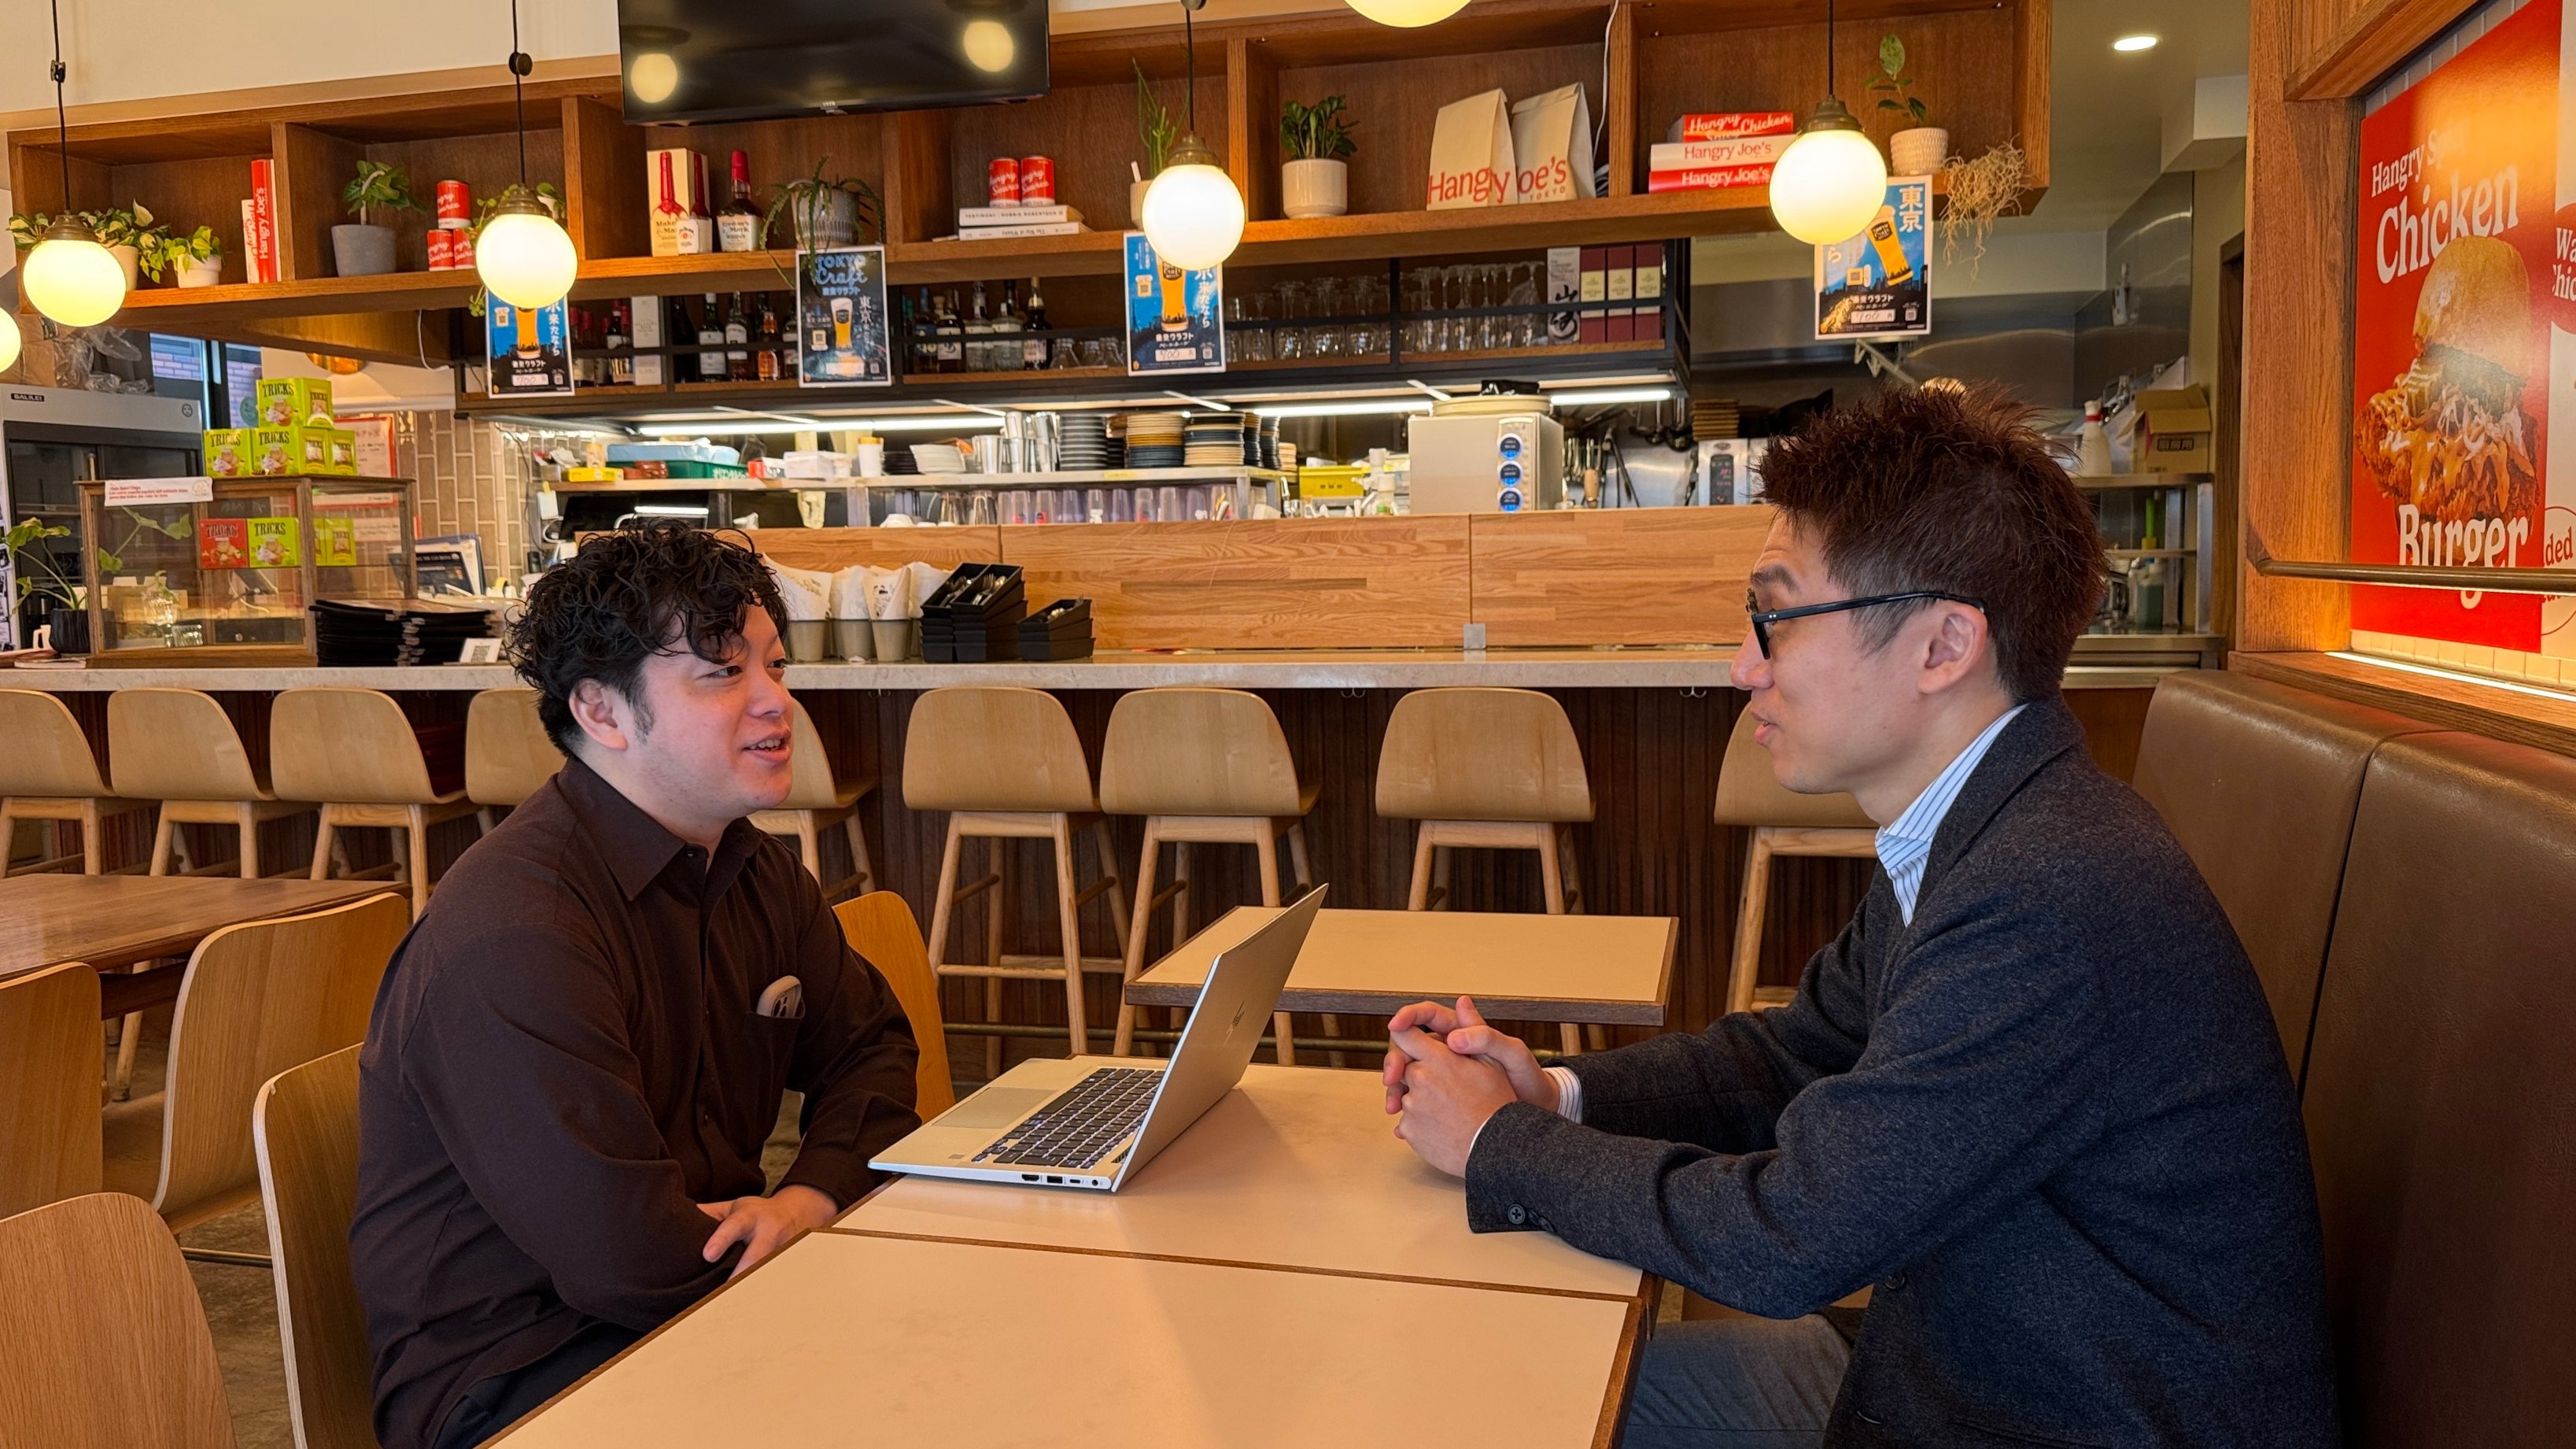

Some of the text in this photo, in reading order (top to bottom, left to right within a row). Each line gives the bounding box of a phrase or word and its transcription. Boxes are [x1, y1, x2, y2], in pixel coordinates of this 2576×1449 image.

[1688, 113, 1791, 134] Hangry Chicken
[1685, 142, 1772, 161] Hangry Joe's
[1517, 156, 1567, 194] oe's
[1681, 166, 1770, 188] Hangry Joe's
[2371, 145, 2425, 198] Hangry
[256, 187, 266, 217] Joe's
[1530, 186, 1566, 201] TOKYO
[1899, 186, 1923, 233] 東京
[2377, 164, 2519, 284] Chicken
[258, 216, 270, 260] Hangry
[815, 254, 866, 268] TOKYO
[816, 267, 868, 287] Craft
[262, 383, 294, 397] TRICKS
[210, 434, 241, 448] TRICKS
[258, 431, 290, 445] TRICKS
[206, 523, 238, 538] TRICKS
[254, 523, 286, 536] TRICKS
[2399, 504, 2529, 609] Burger
[2544, 526, 2573, 567] ded
